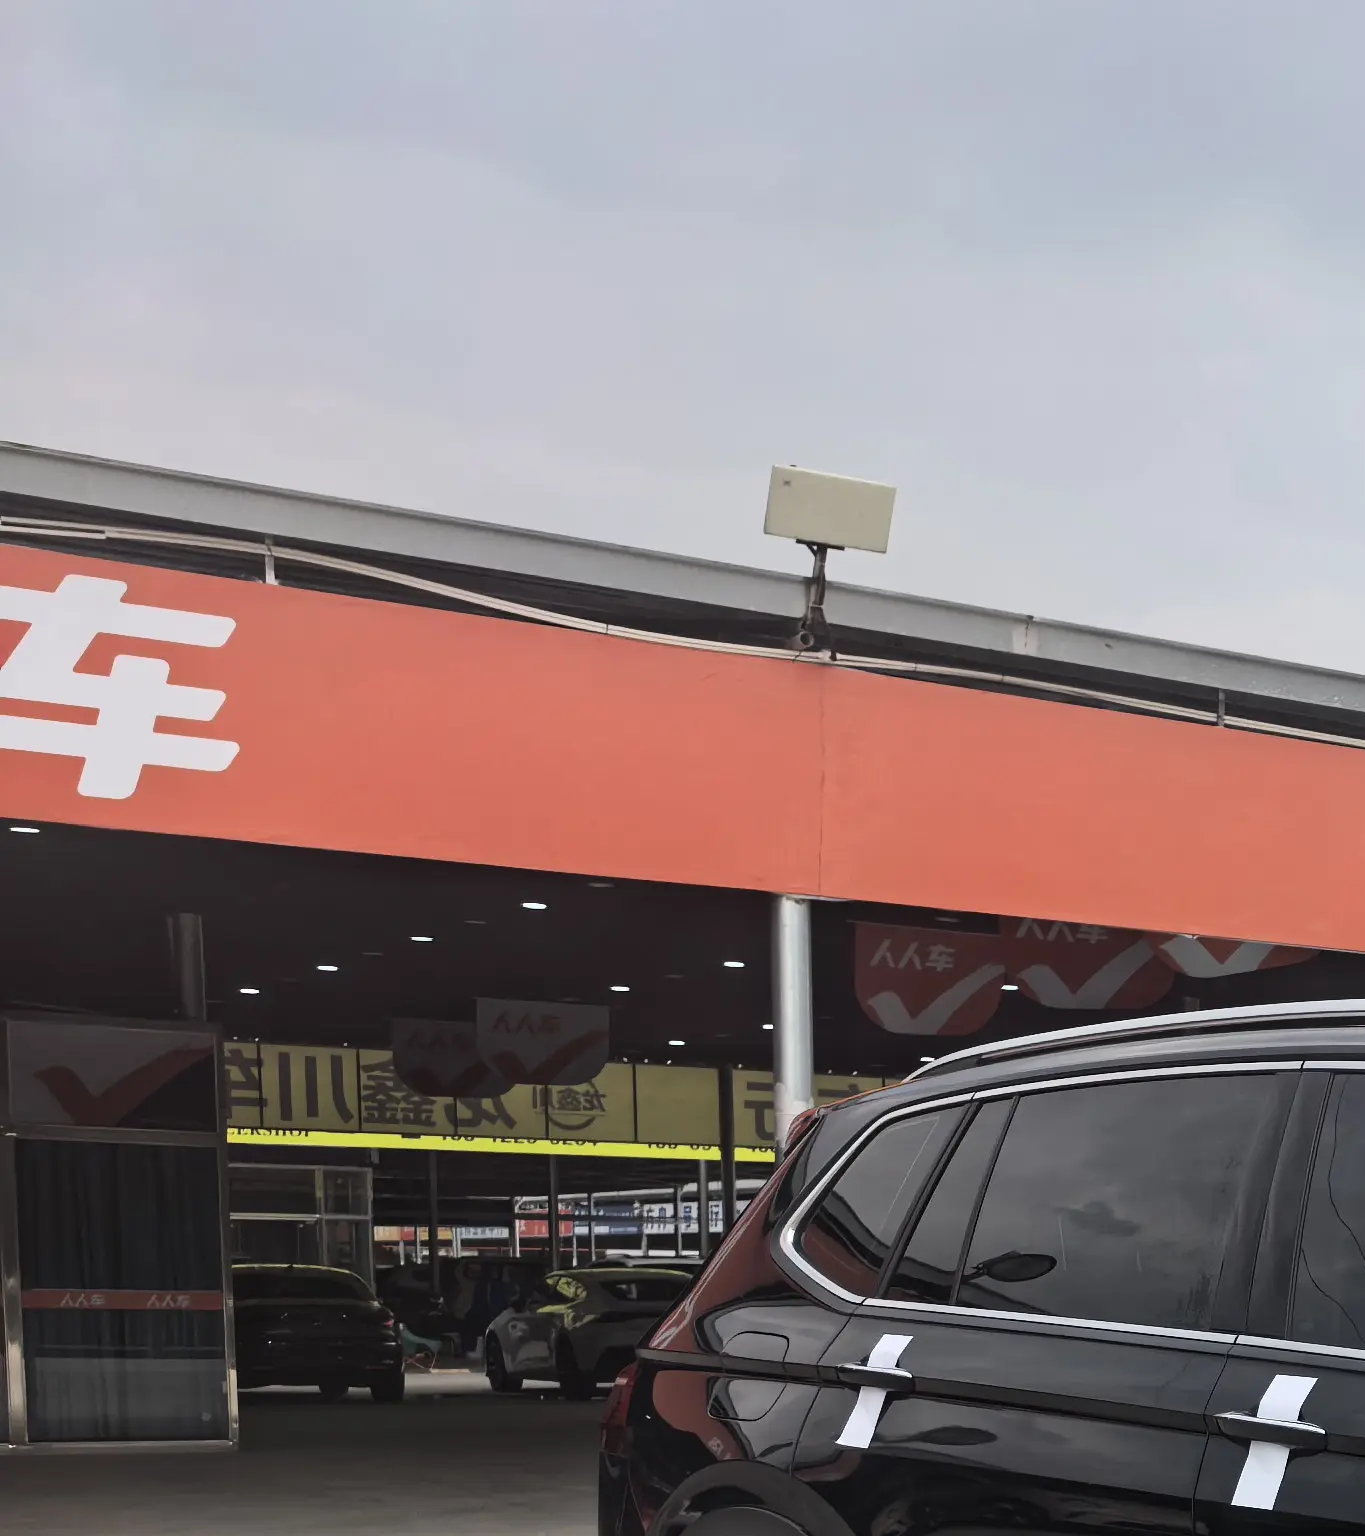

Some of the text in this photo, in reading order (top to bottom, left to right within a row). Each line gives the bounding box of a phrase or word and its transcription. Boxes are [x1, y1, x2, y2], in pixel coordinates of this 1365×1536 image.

[0, 573, 240, 800] 车
[869, 938, 957, 973] 人人车
